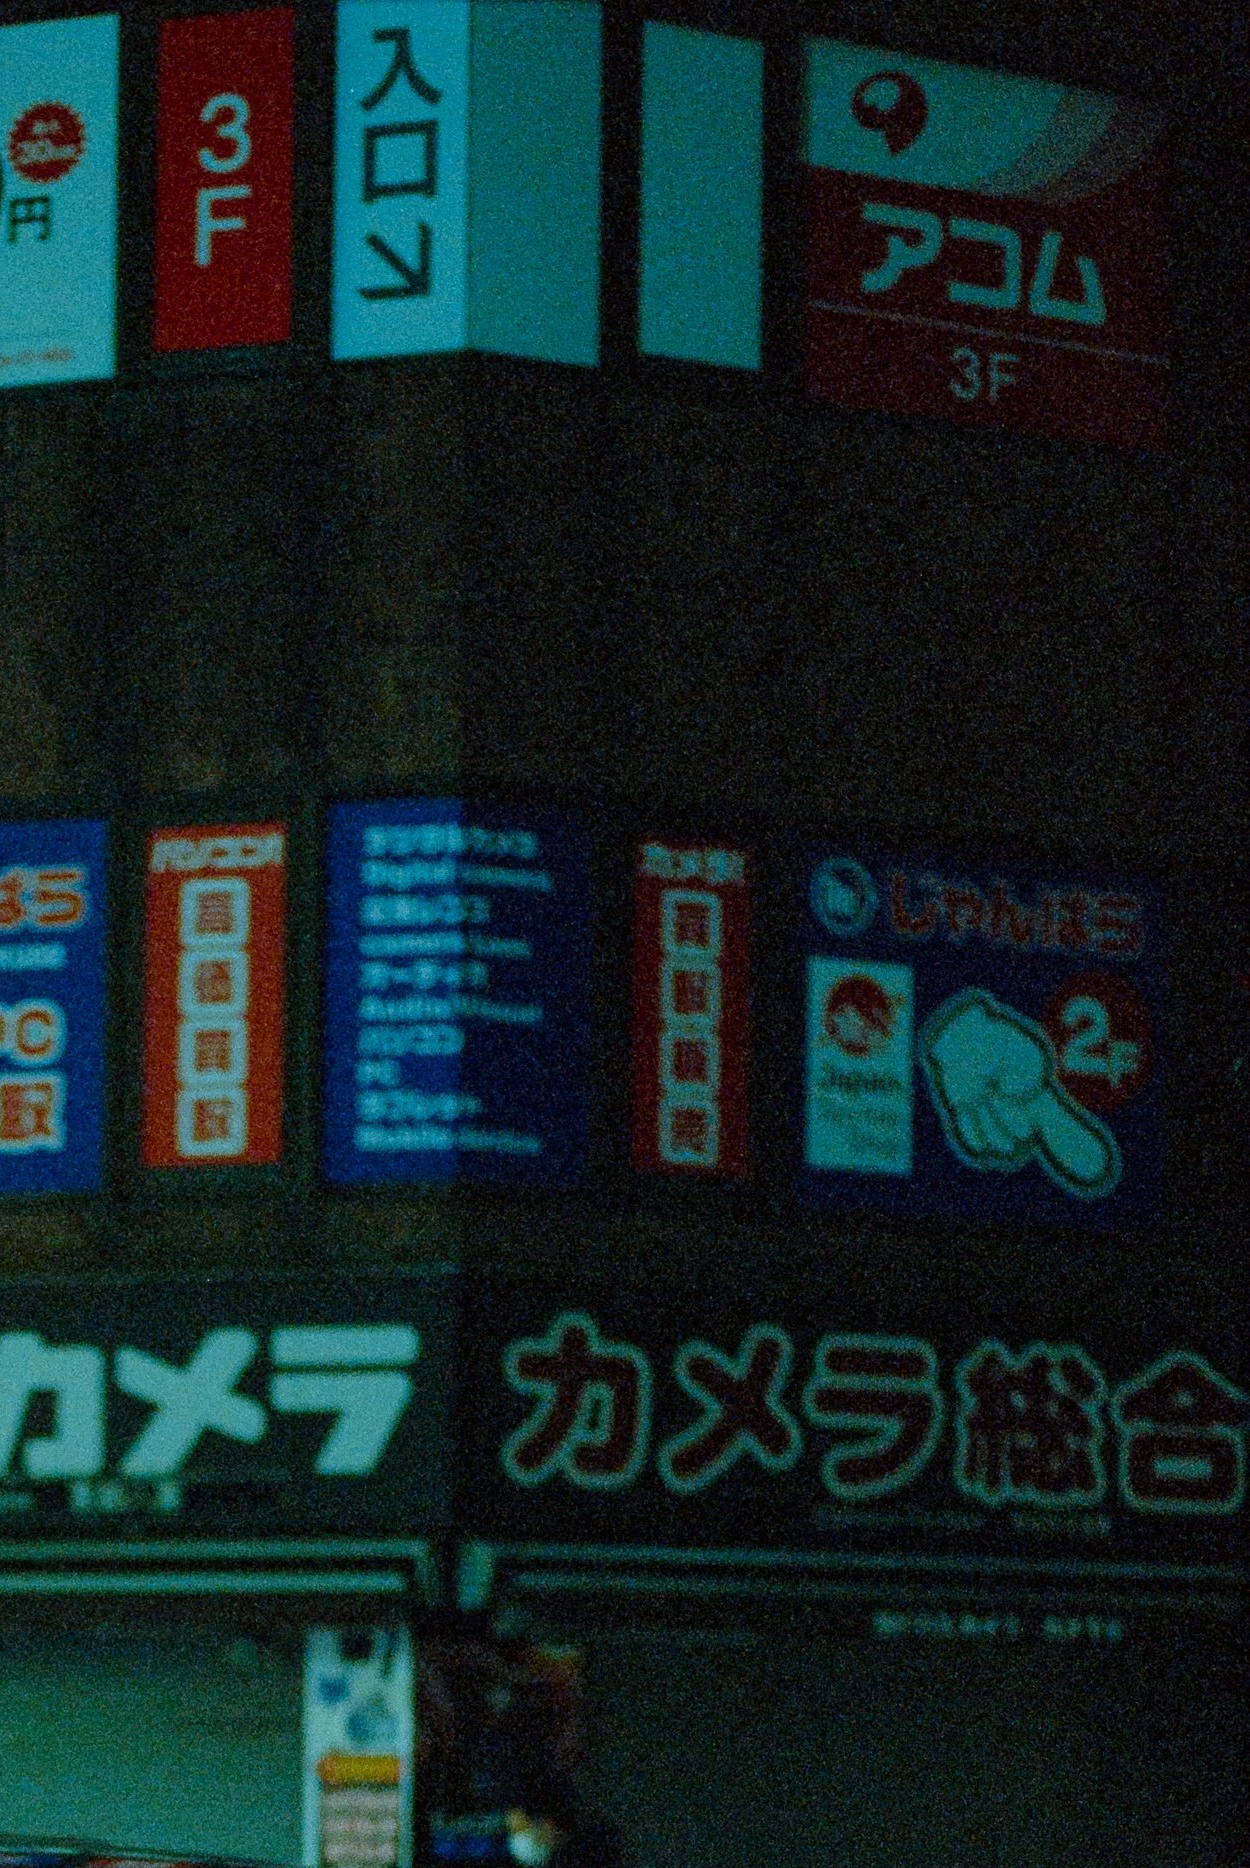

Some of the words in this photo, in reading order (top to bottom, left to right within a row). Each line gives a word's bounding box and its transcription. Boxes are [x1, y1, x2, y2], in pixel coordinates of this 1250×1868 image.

[195, 92, 252, 267] 3F
[361, 27, 444, 203] 入口
[860, 202, 1108, 327] アコム
[951, 345, 1021, 402] 3F
[503, 1310, 1250, 1515] カメラ総合
